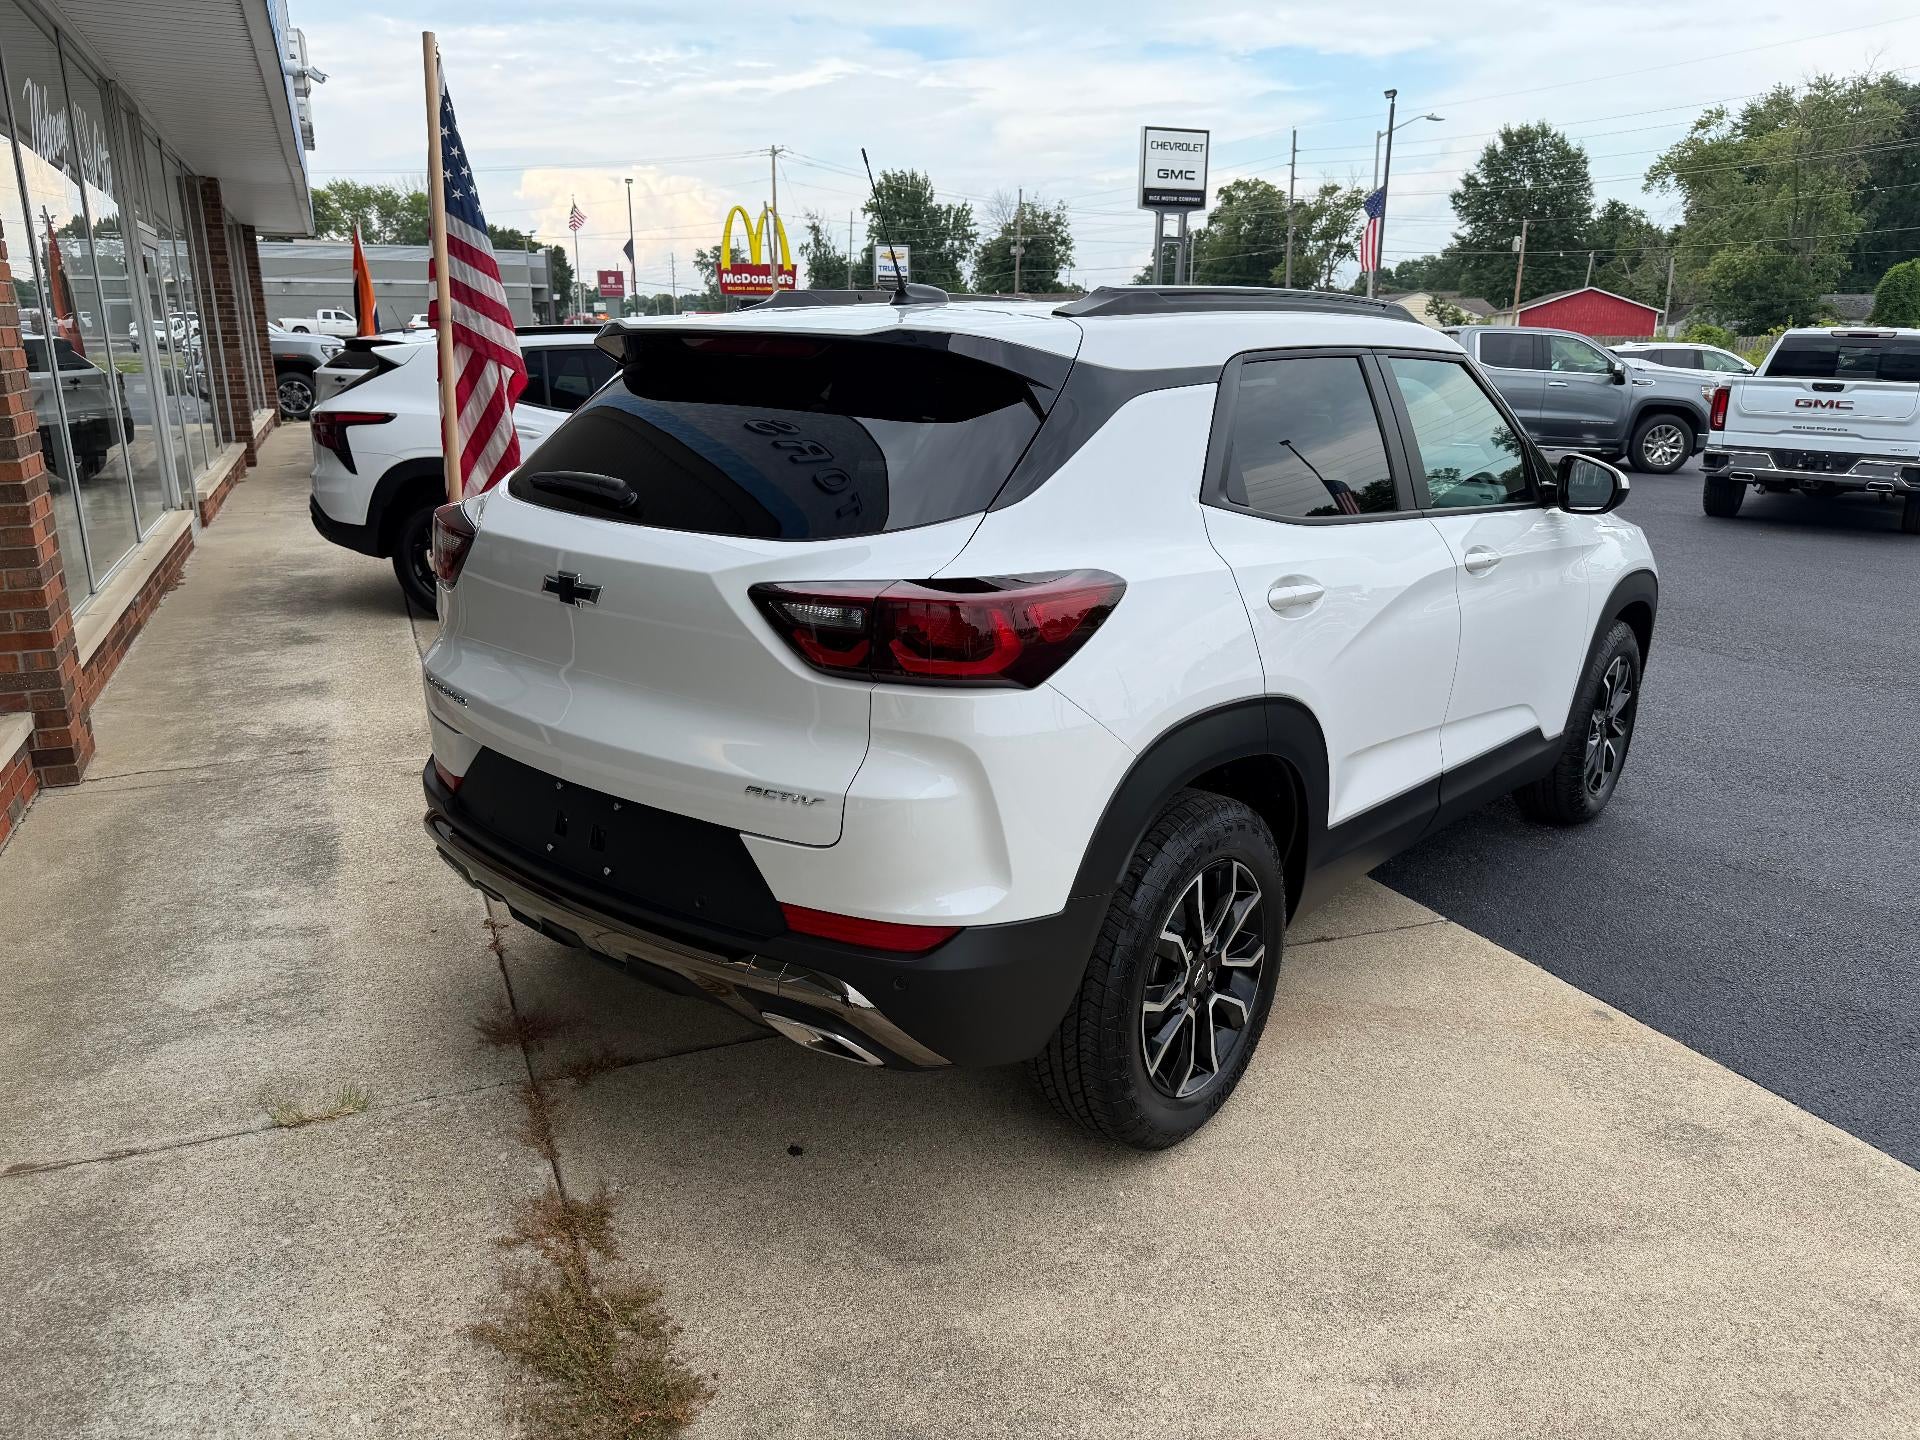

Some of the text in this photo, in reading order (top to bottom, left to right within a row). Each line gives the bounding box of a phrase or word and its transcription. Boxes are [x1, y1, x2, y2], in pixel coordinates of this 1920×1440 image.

[1150, 140, 1205, 152] CHEVROLET
[1157, 169, 1195, 180] GMC
[721, 273, 794, 285] McDonad's
[1795, 399, 1854, 410] GMC
[745, 785, 825, 806] ACTIV
